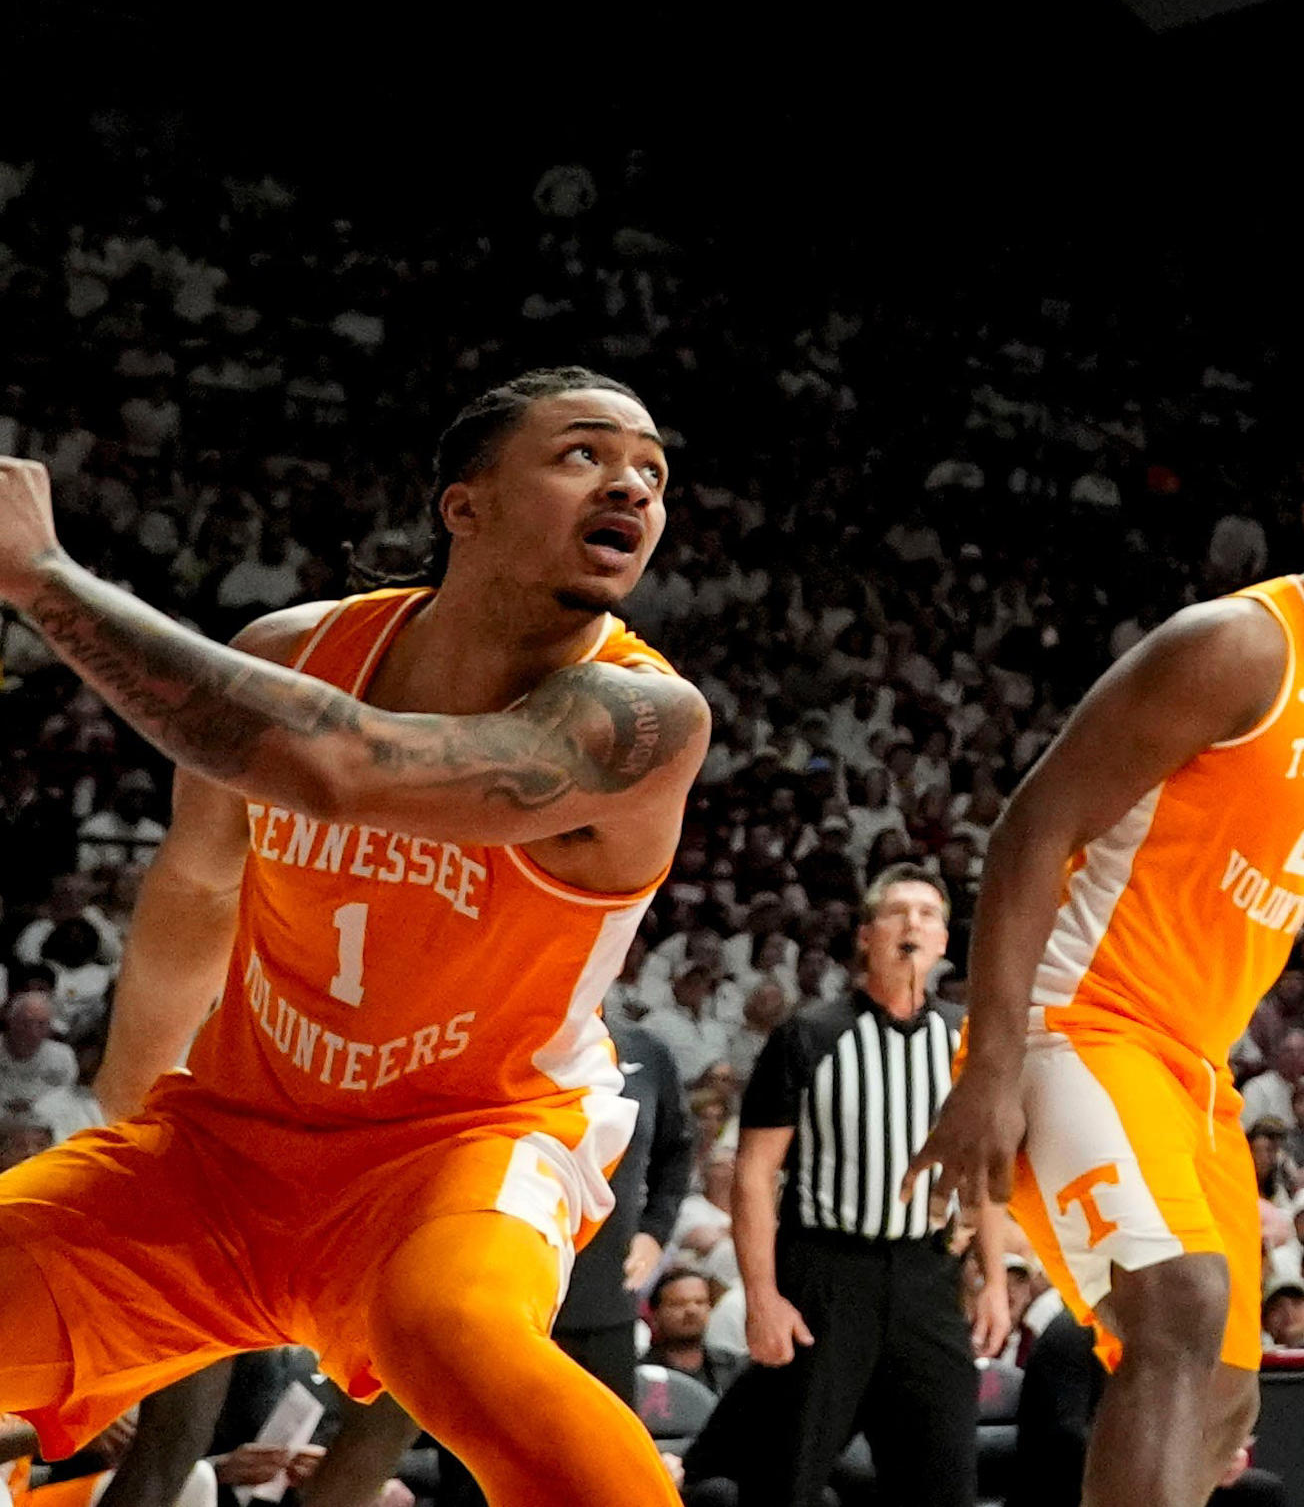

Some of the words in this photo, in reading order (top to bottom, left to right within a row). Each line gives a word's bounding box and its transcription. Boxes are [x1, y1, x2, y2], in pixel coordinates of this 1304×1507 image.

[247, 802, 487, 920] TENNESSEE
[329, 901, 370, 1008] 1
[1056, 1162, 1120, 1250] T
